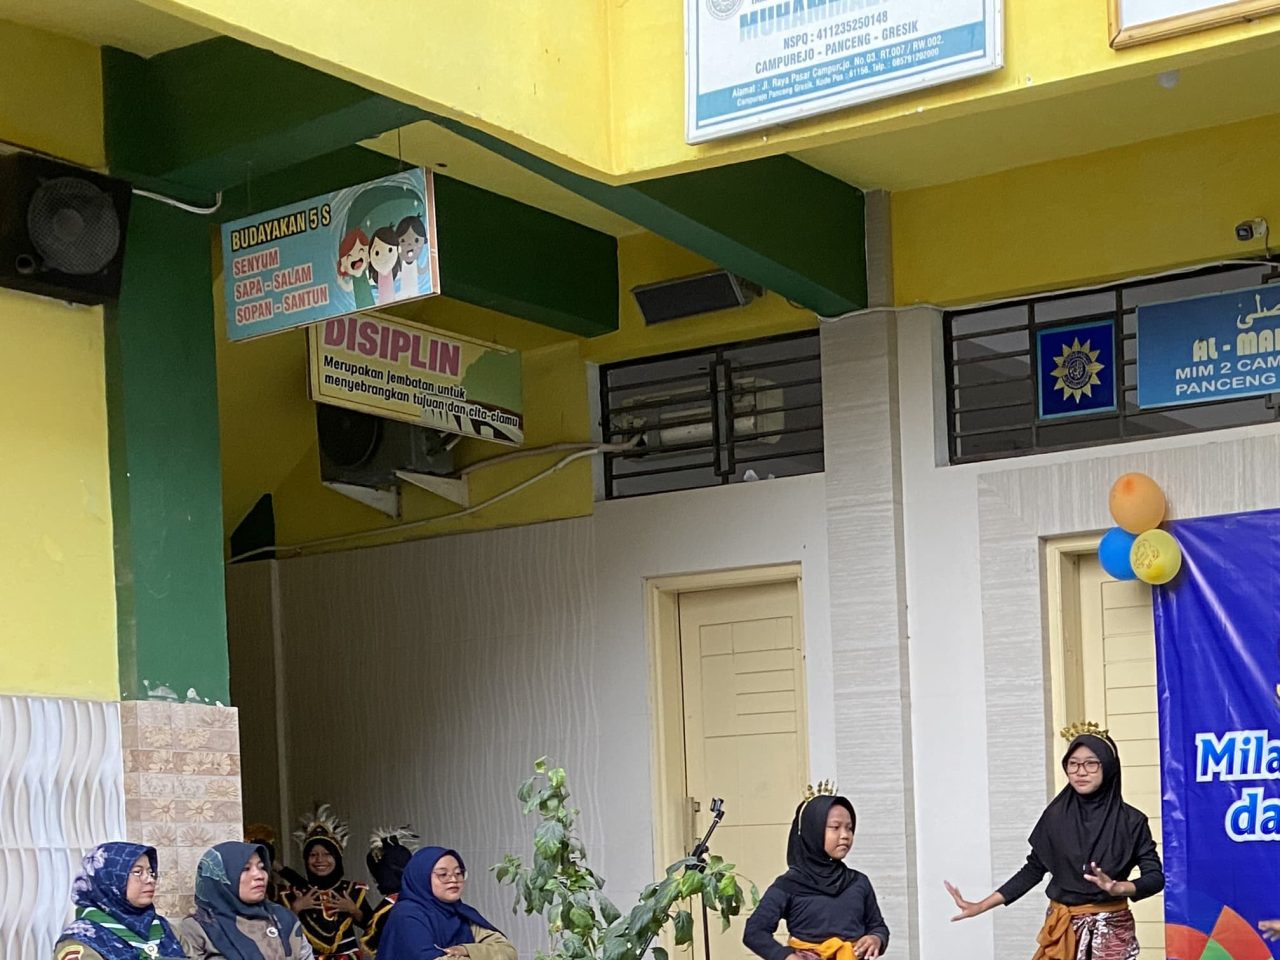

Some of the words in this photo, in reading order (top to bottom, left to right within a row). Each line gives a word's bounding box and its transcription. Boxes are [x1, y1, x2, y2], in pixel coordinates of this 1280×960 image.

[816, 10, 888, 40] 411235250148
[755, 48, 815, 74] CAMPUREJO
[826, 33, 871, 57] PANCENG
[882, 20, 918, 40] GRESIK
[732, 84, 756, 98] Alamat
[772, 76, 789, 88] Raya
[791, 71, 810, 83] Pasar
[231, 211, 306, 252] BUDAYAKAN
[309, 207, 318, 229] 5
[321, 204, 331, 225] S
[234, 249, 279, 276] SENYUM
[235, 278, 263, 300] SAPA
[274, 265, 312, 290] SALAM
[236, 301, 272, 324] SOPAN
[284, 286, 328, 312] SANTUN
[324, 317, 460, 377] DISIPLIN
[1192, 337, 1218, 362] AL
[323, 355, 383, 381] Merupakan
[437, 384, 466, 400] untuk
[1175, 364, 1214, 380] MIM
[1220, 362, 1232, 374] 2
[1175, 372, 1277, 396] PANCENG
[325, 375, 409, 403] menyebrangkan
[413, 393, 444, 411] tujuan
[448, 401, 469, 417] dan
